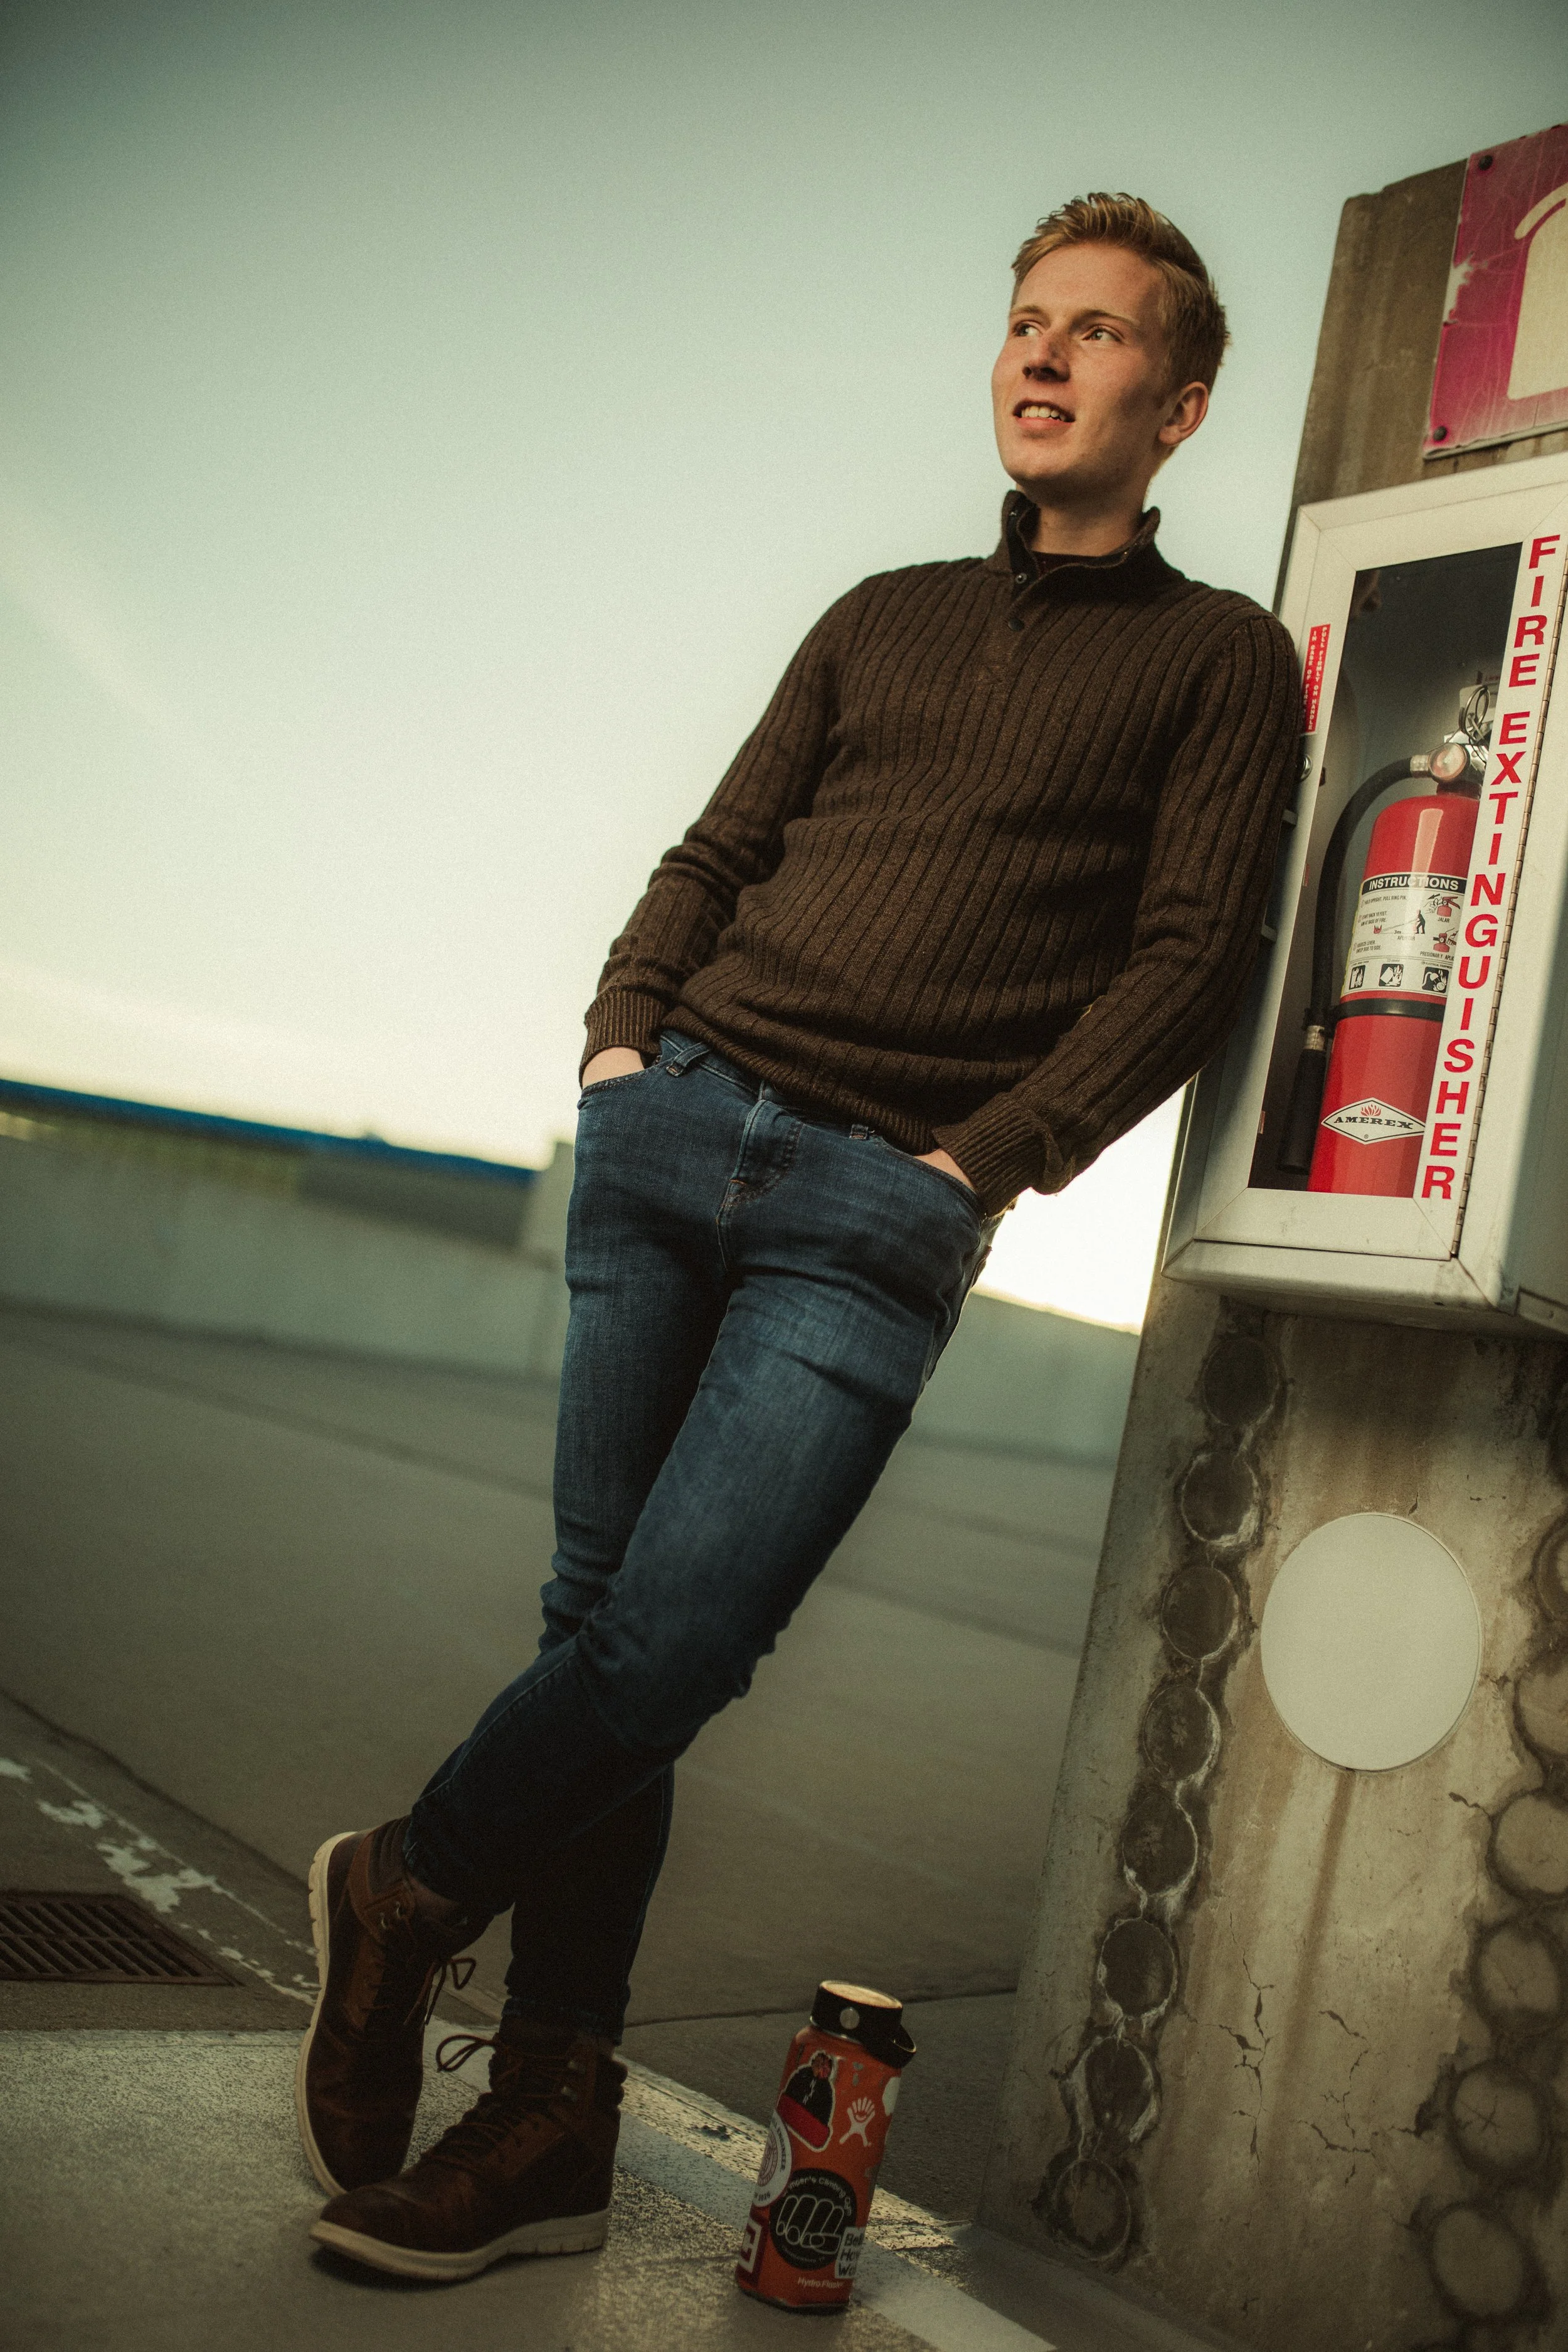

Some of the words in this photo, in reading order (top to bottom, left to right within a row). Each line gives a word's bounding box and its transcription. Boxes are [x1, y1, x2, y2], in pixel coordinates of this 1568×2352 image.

[1508, 534, 1560, 687] FIRE
[1312, 630, 1316, 641] IN
[1306, 669, 1312, 681] OF
[1316, 650, 1324, 682] FIRMLY
[1313, 684, 1319, 696] ON
[1308, 699, 1316, 730] HANDLE
[1369, 876, 1458, 891] INSTRUCTIONS
[1421, 711, 1530, 1199] EXTINGUISHER
[1333, 1116, 1414, 1130] AMEREX
[776, 2127, 787, 2172] ENGINEER
[818, 2176, 846, 2198] Climbing
[798, 2277, 821, 2289] Hydro
